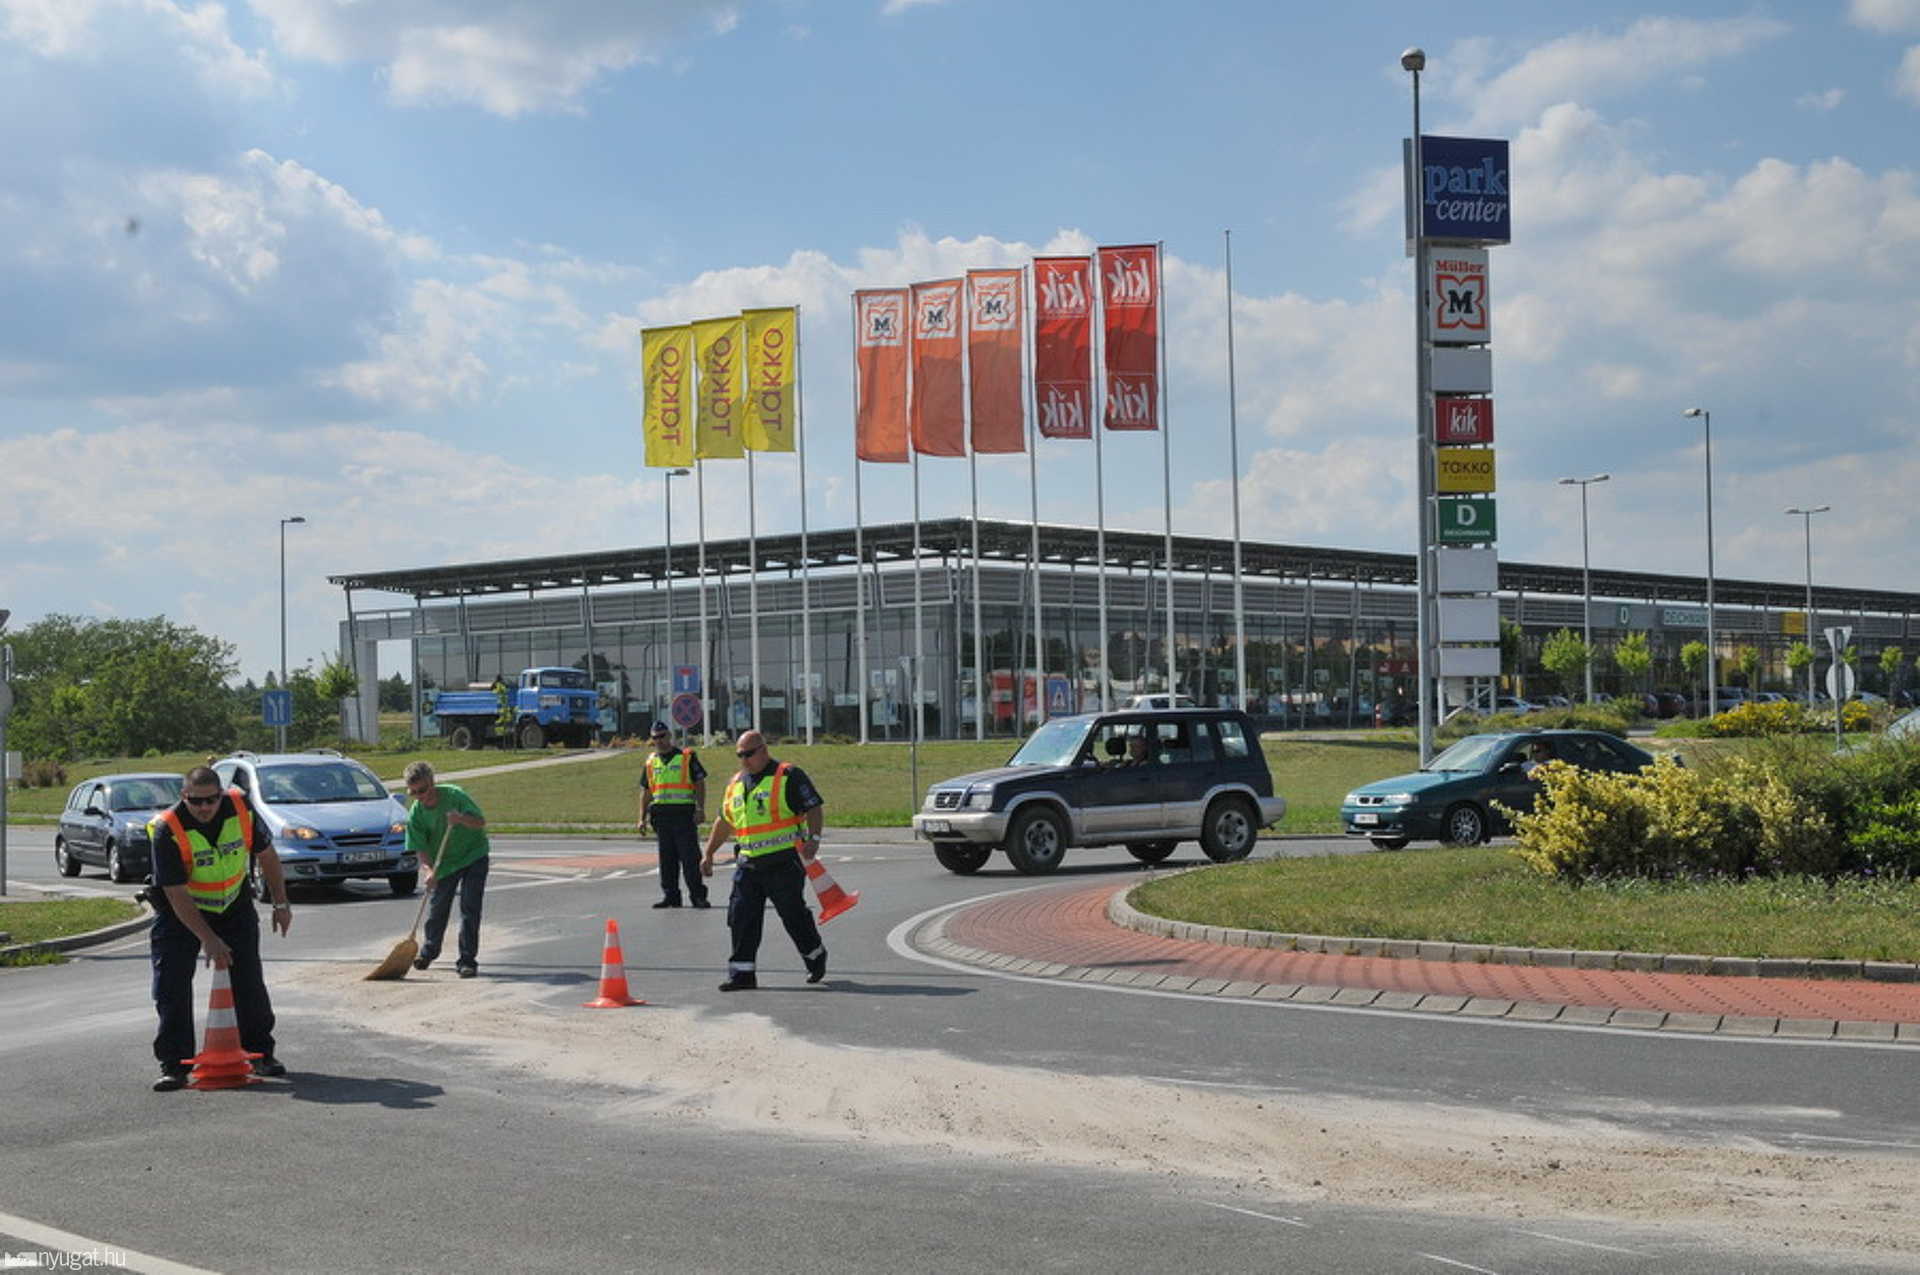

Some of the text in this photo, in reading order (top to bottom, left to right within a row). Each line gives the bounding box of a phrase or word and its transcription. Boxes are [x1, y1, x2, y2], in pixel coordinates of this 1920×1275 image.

[1424, 157, 1507, 204] park
[1436, 196, 1507, 223] center
[1447, 290, 1473, 314] M
[1450, 404, 1479, 434] kik
[1456, 504, 1477, 526] D
